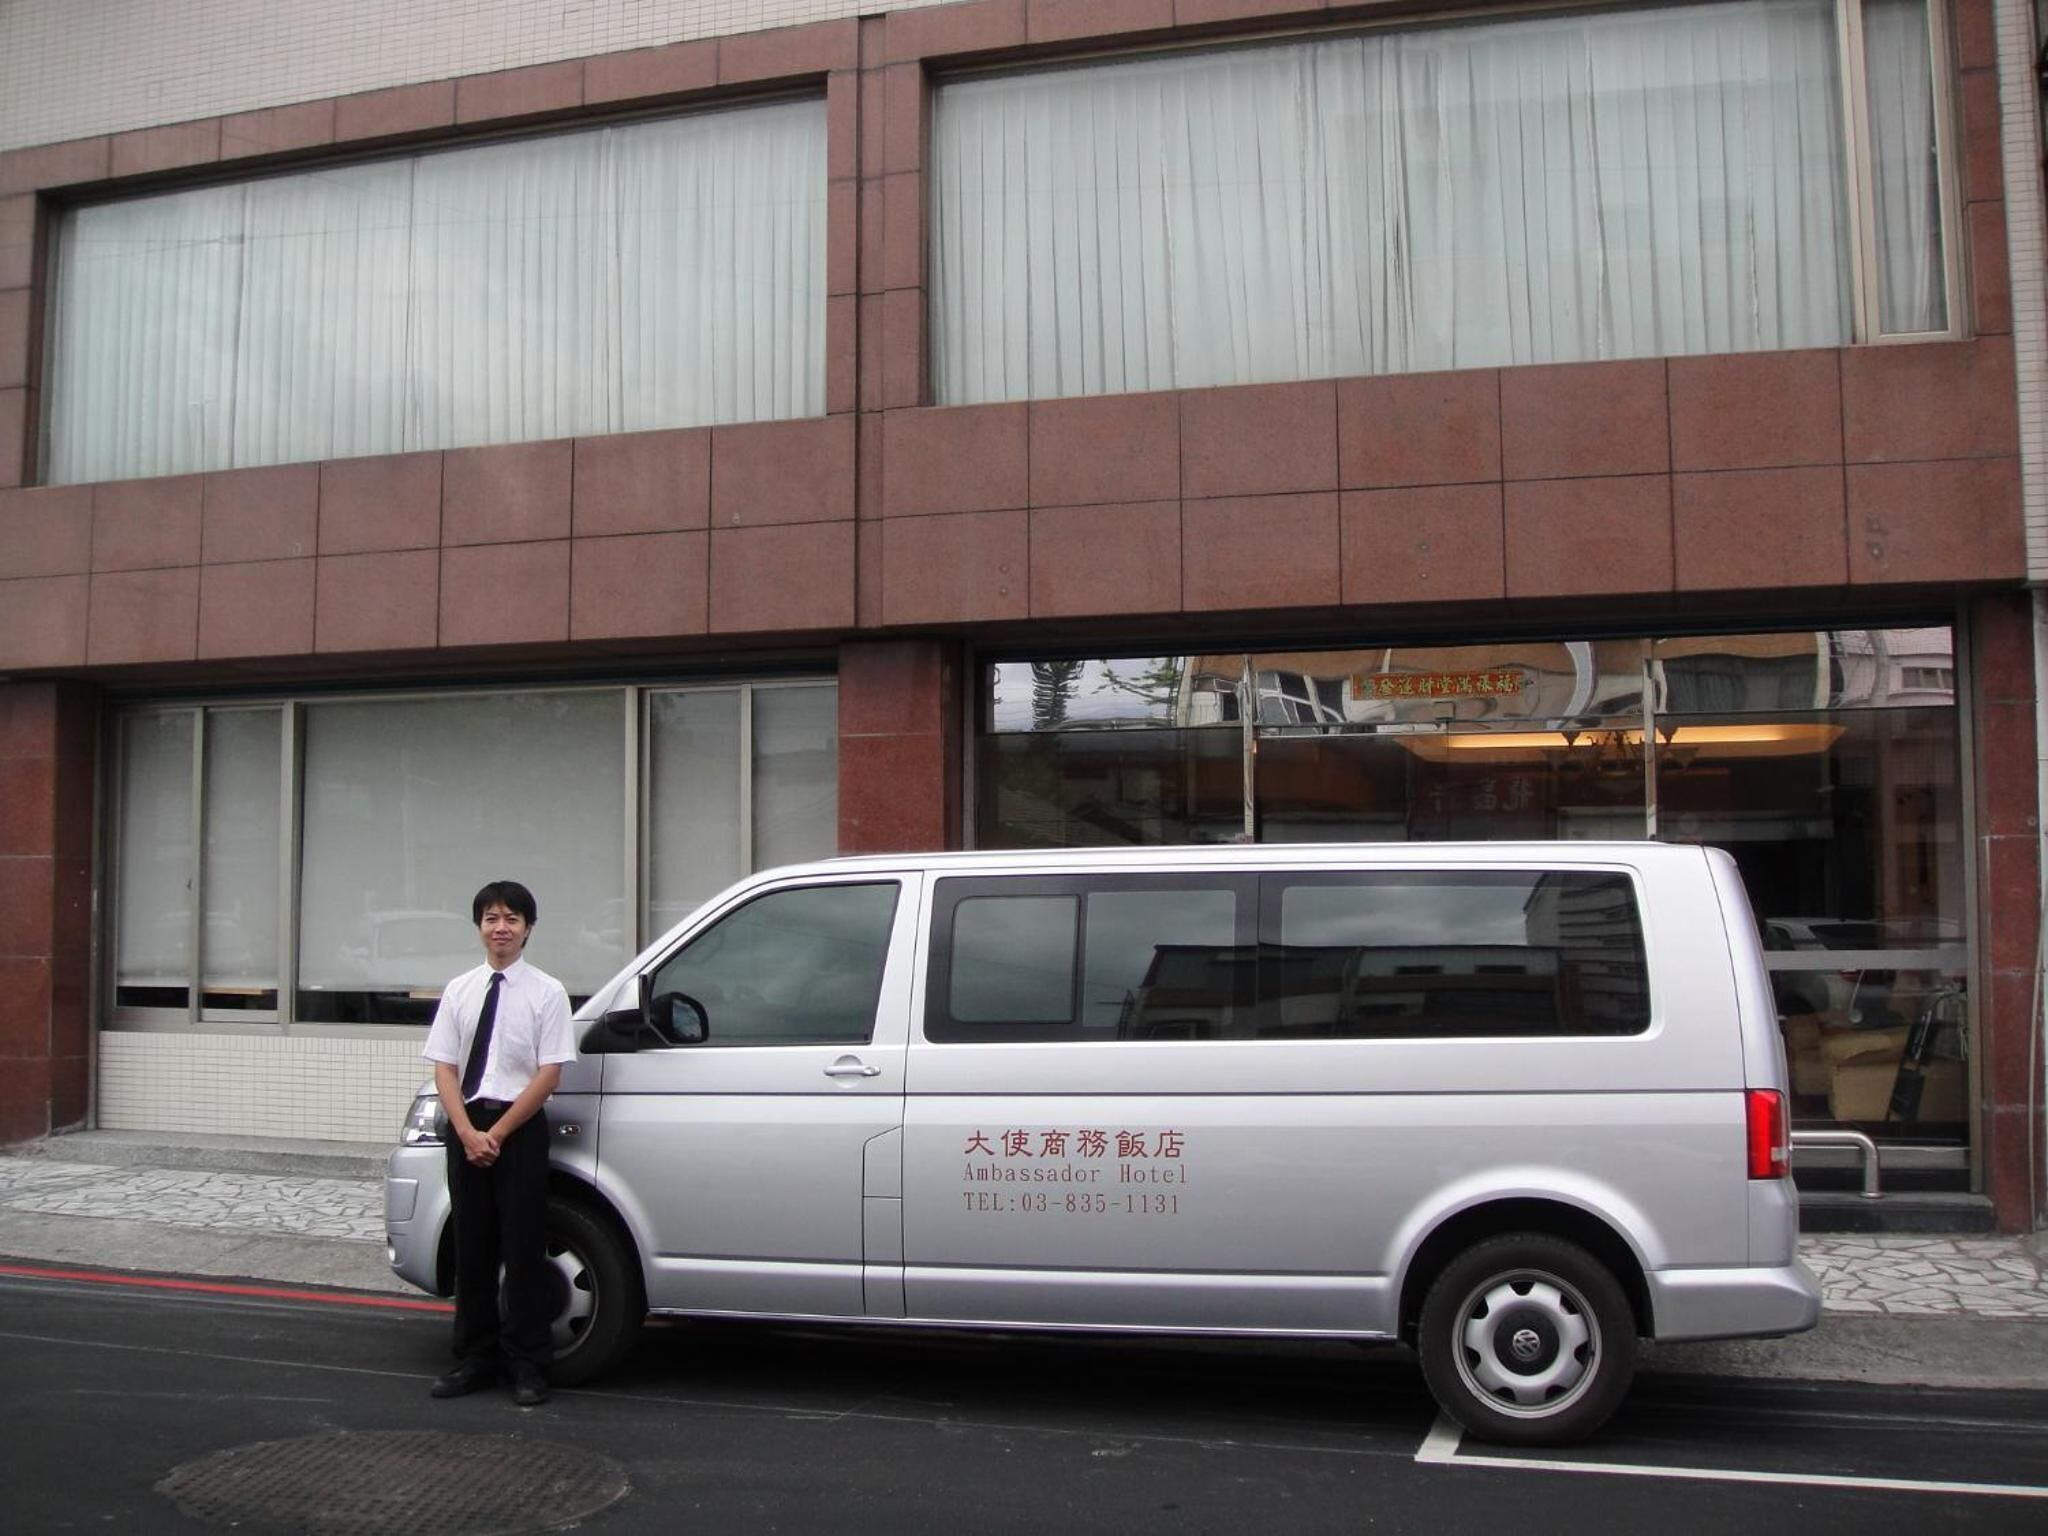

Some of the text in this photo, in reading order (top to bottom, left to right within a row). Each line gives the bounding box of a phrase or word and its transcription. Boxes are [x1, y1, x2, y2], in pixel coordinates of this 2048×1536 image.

[964, 1129, 1185, 1158] 大使商務飯店
[963, 1163, 1187, 1184] Ambassador Hotel
[963, 1192, 1179, 1214] TEL:03-835-1131
